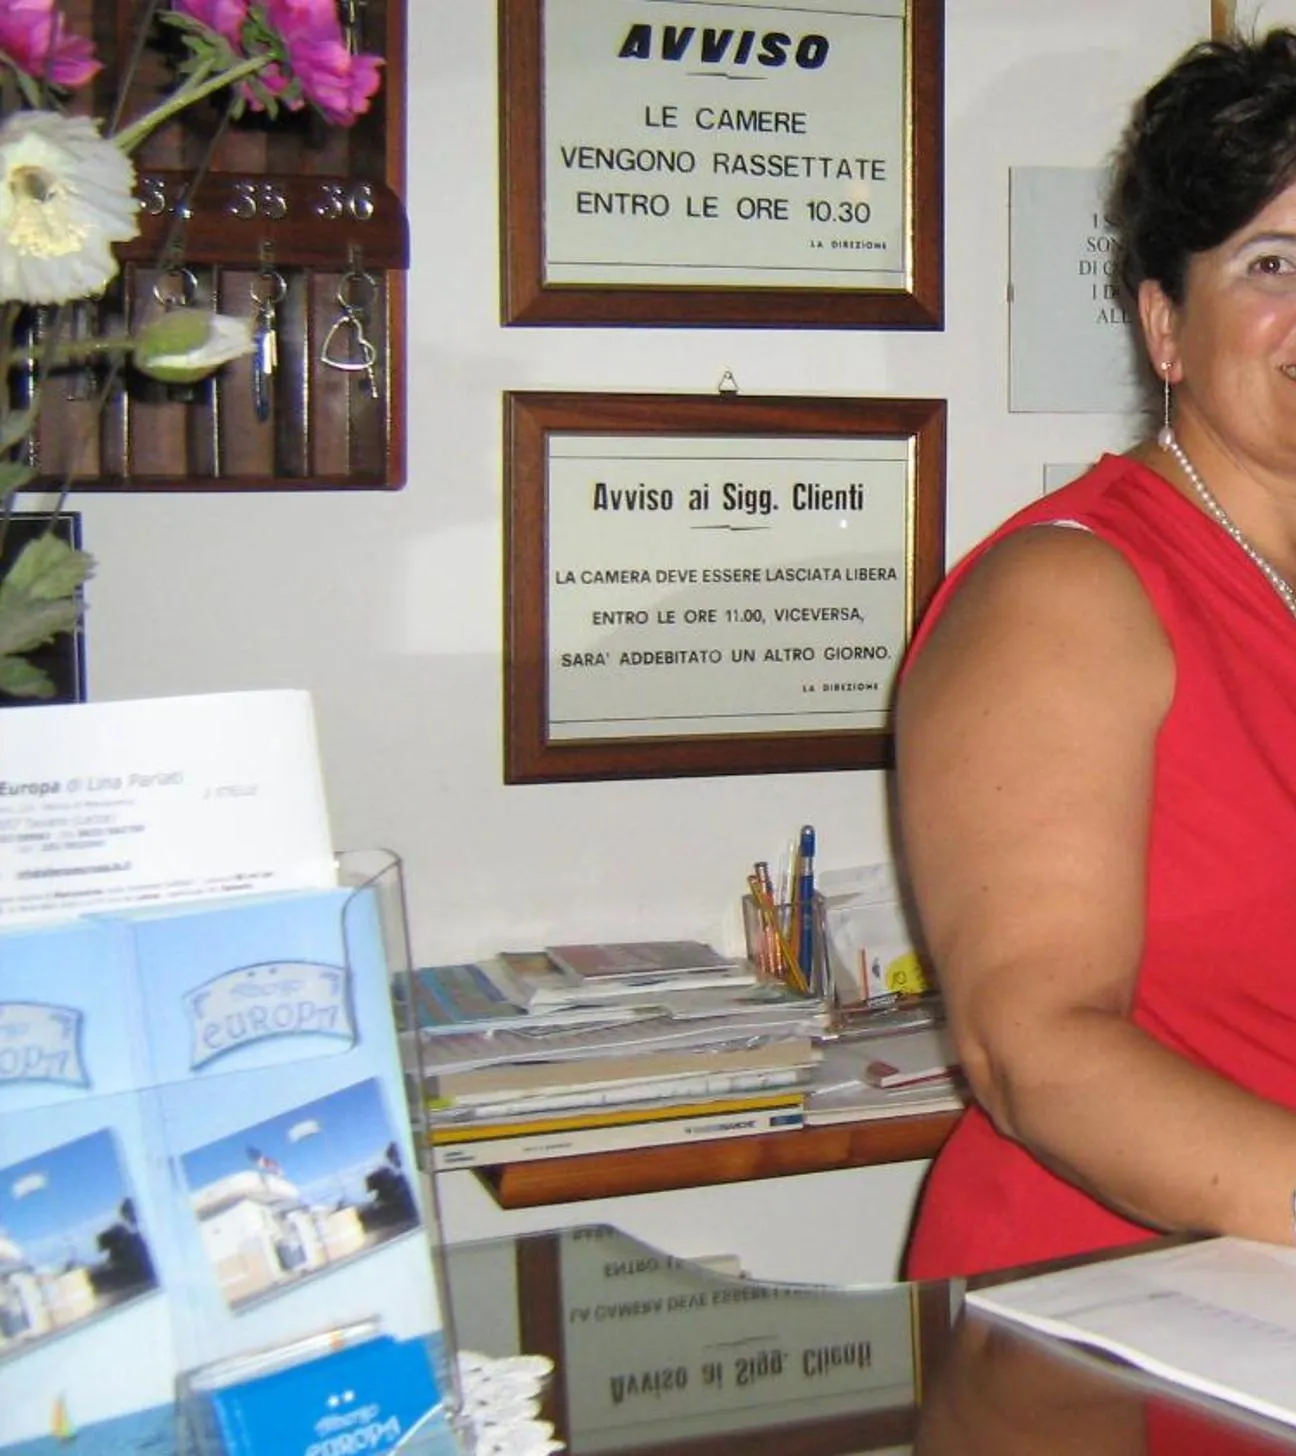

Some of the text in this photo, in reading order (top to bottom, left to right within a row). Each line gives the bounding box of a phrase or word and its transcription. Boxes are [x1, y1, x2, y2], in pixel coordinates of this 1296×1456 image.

[617, 23, 831, 70] AVVISO
[645, 105, 808, 135] LE CAMERE
[560, 145, 887, 181] VENGONO RASSETTATE
[576, 191, 872, 225] ENTRO LE ORE 10.30
[592, 481, 865, 516] Avviso ai Sigg. Clienti
[555, 566, 898, 586] LA CAMERA DEVE ESSERE LASCIATA LIBERA
[592, 607, 865, 626] ENTRO LE ORE 11.00, VICEVERSA,
[561, 645, 892, 668] SARA' ADDEBITATO UN ALTRO GIORNO.
[0, 780, 61, 798] Europa
